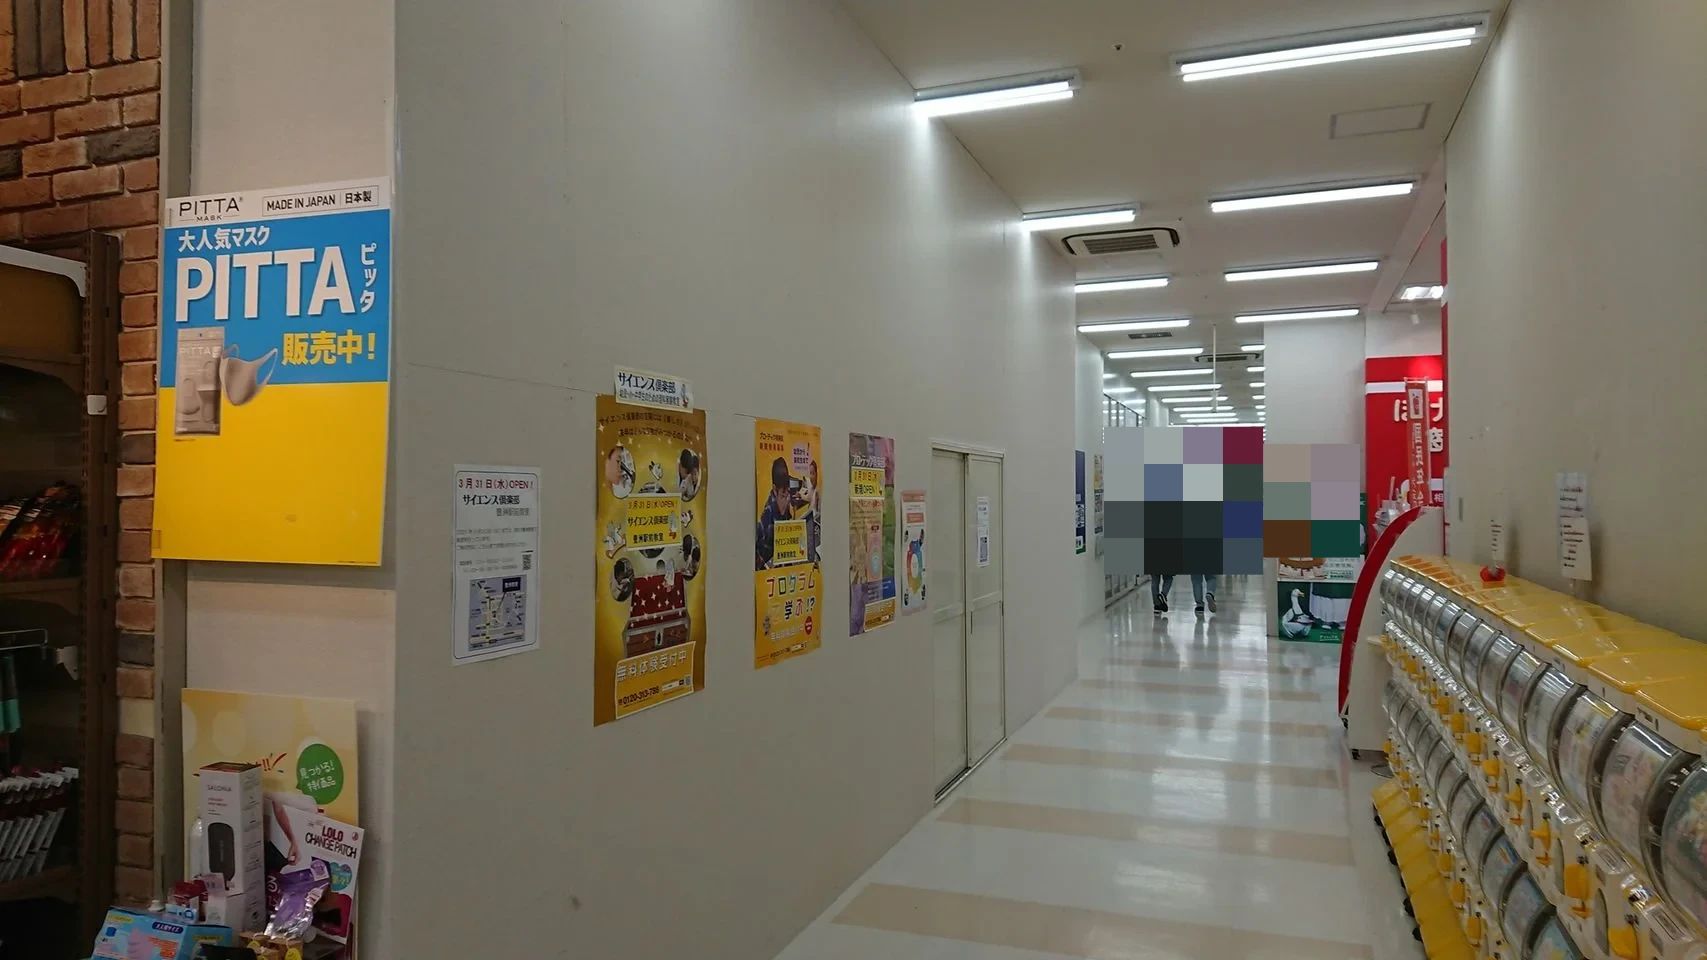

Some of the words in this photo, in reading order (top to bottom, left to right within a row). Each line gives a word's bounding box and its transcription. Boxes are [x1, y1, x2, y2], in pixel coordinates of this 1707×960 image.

[179, 197, 240, 217] PITTA
[266, 201, 293, 211] MADE
[295, 200, 304, 209] IN
[305, 195, 336, 207] JAPAN
[344, 191, 372, 205] 日本製
[178, 225, 271, 252] 大人気マスク
[175, 245, 356, 323] PITTA
[359, 242, 377, 313] ピッタ
[281, 329, 377, 366] 販売中!
[322, 825, 344, 842] LOLO
